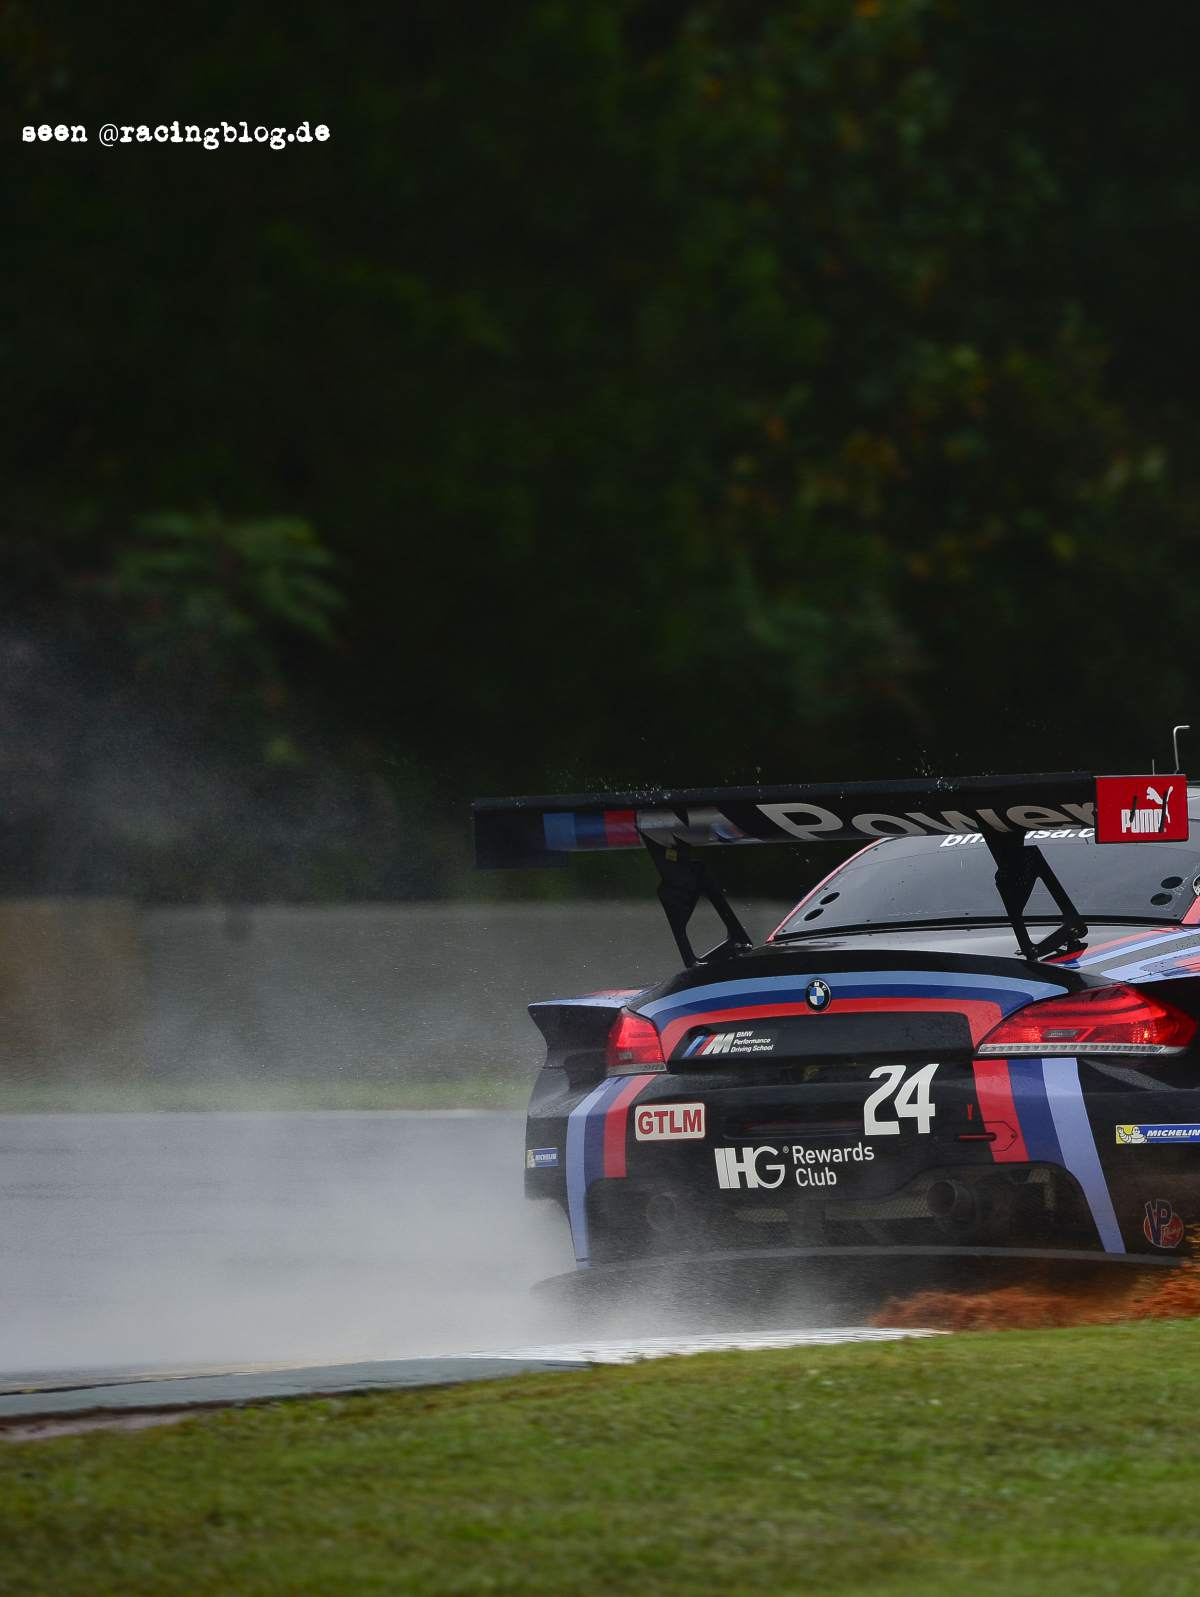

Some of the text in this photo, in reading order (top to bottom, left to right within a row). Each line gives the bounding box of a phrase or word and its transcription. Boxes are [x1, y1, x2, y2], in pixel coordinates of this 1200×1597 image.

[756, 802, 1095, 841] Power
[733, 1038, 772, 1046] Performance
[736, 1030, 754, 1038] BMW
[730, 1044, 775, 1054] Driving School
[864, 1063, 940, 1136] 24
[637, 1109, 703, 1135] GTLM
[1146, 1128, 1200, 1138] MICHELIN
[792, 1142, 875, 1165] Rewards
[795, 1166, 837, 1187] Club
